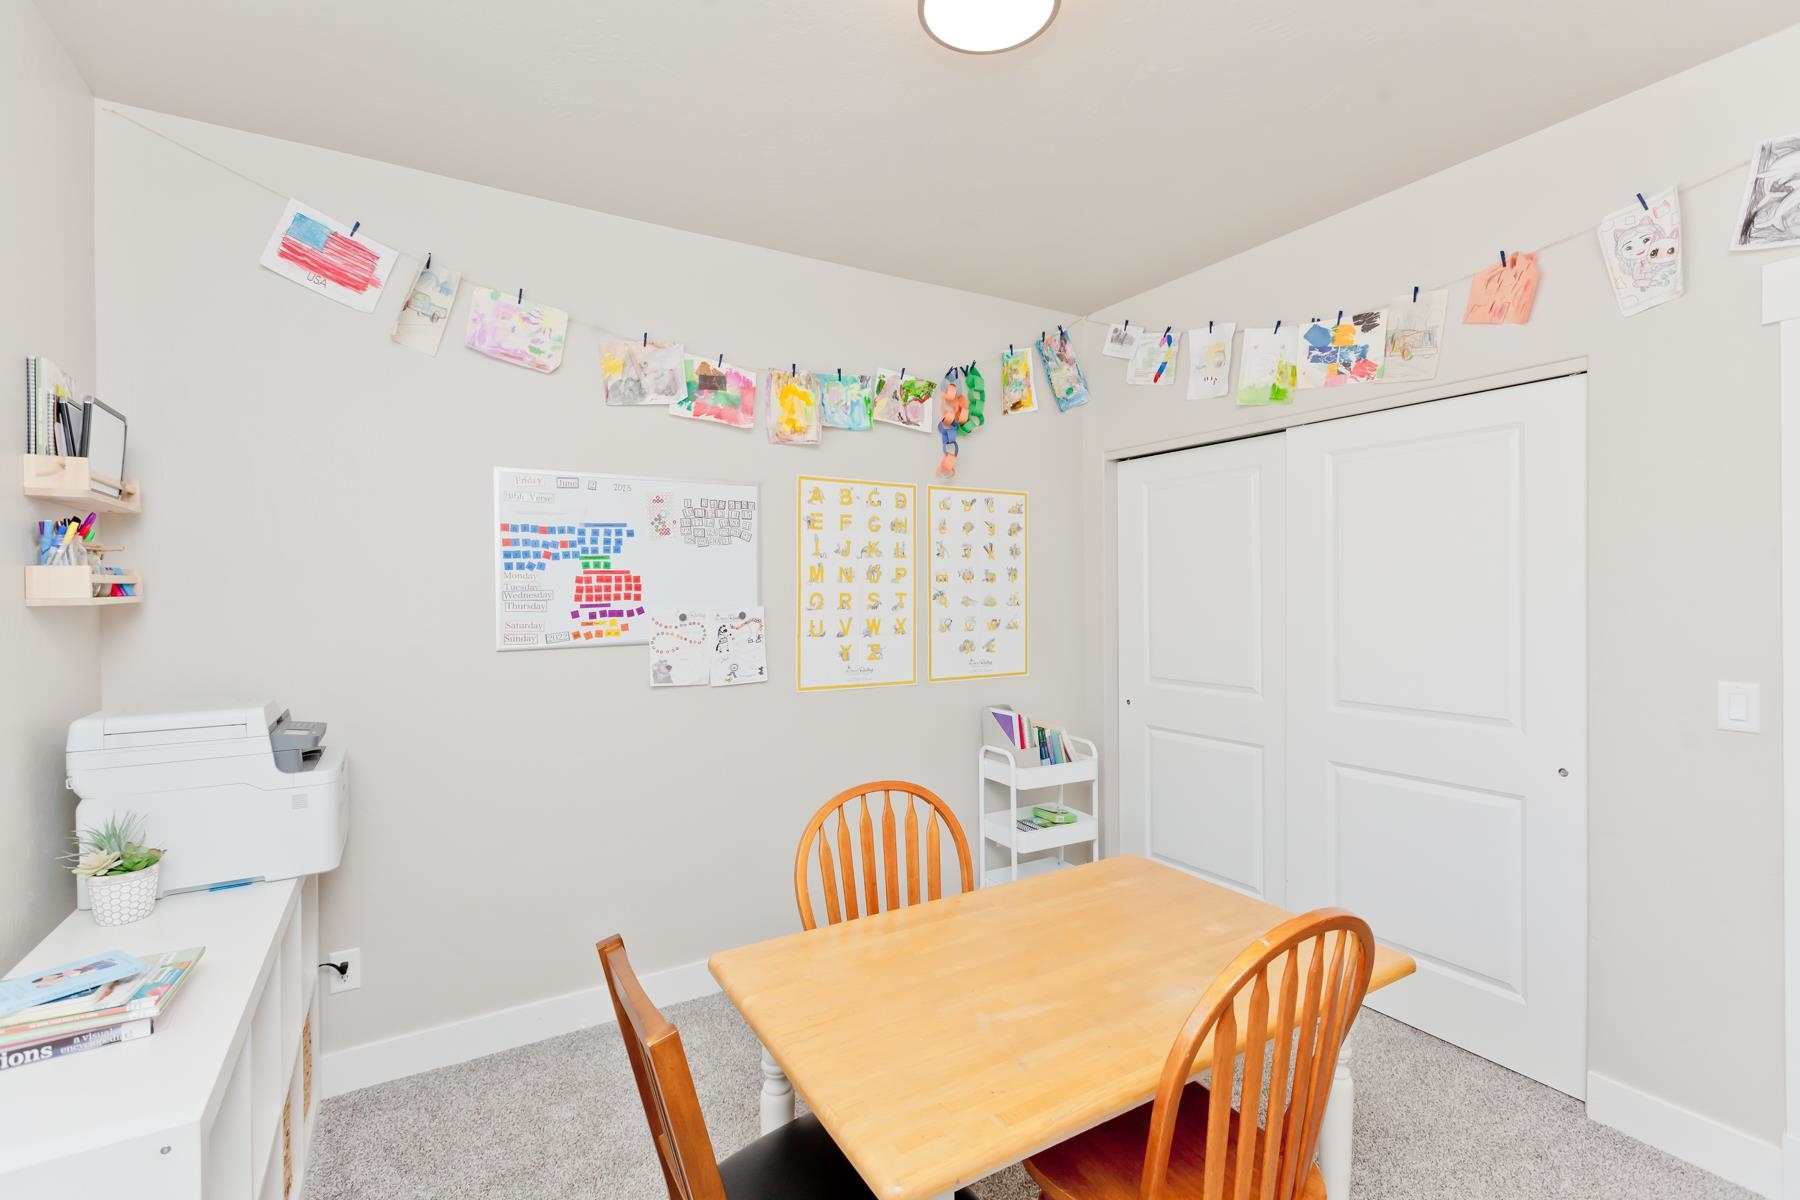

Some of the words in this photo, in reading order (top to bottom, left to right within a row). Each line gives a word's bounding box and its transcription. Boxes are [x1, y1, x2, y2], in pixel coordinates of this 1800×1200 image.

[306, 272, 327, 288] USA
[559, 479, 578, 488] June
[808, 486, 824, 504] A
[839, 488, 853, 506] B
[895, 492, 907, 508] D
[810, 513, 824, 530] E
[839, 514, 853, 531] F
[867, 515, 881, 533] G
[895, 517, 907, 534] H
[840, 539, 852, 557] J
[895, 541, 907, 559] L
[503, 571, 538, 581] Monday
[808, 565, 824, 583] M
[839, 566, 853, 584] N
[895, 567, 907, 584] P
[504, 583, 539, 591] Tuesday
[503, 591, 552, 600] Wednesday
[839, 592, 853, 610] R
[867, 592, 881, 610] S
[895, 592, 907, 609] T
[506, 601, 546, 610] Thursday
[504, 621, 543, 631] Saturday
[809, 619, 824, 637] U
[839, 617, 853, 636] V
[866, 618, 881, 636] W
[895, 617, 907, 635] X
[503, 633, 537, 643] Sunday
[839, 643, 852, 662] Y
[867, 644, 881, 661] Z
